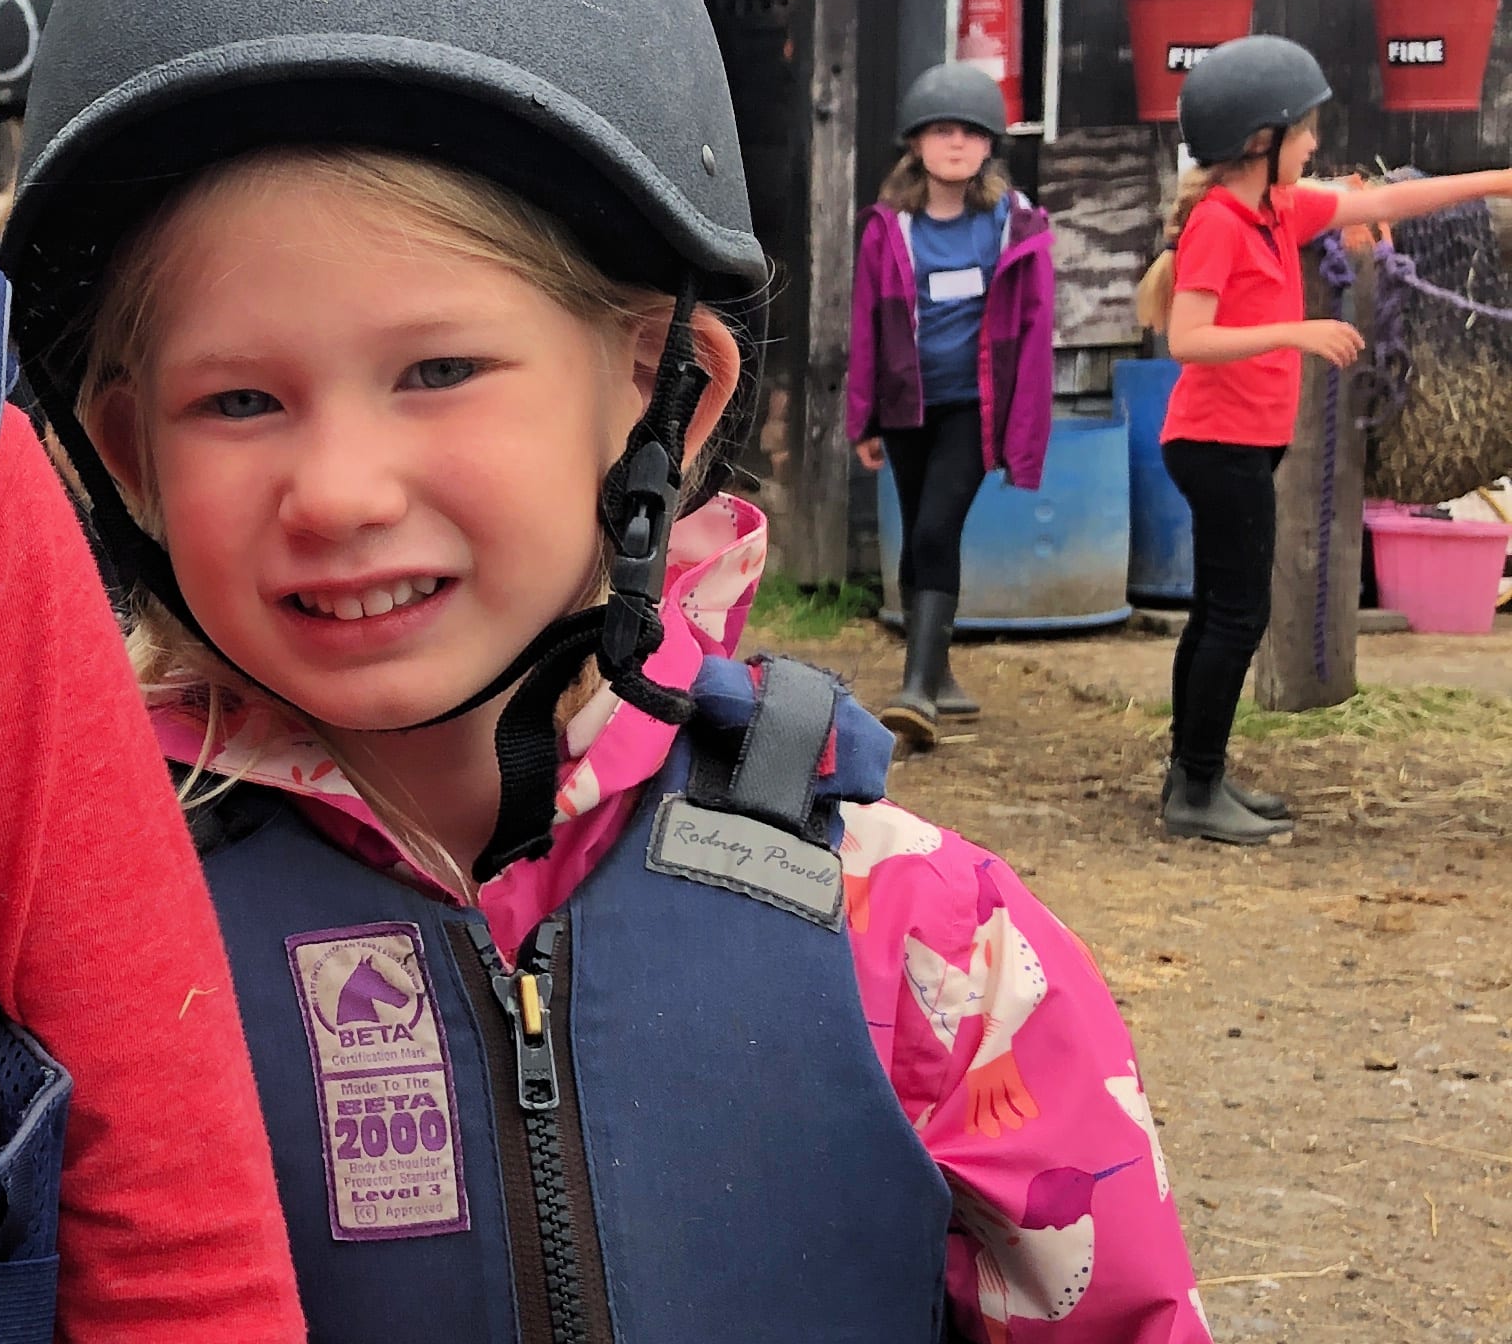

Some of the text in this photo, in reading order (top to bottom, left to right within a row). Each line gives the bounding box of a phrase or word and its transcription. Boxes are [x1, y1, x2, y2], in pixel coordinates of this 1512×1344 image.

[1168, 47, 1212, 69] FI
[1388, 40, 1443, 63] FIRE
[673, 821, 833, 886] Rodney Powell
[338, 1023, 414, 1048] BETA
[331, 1047, 426, 1066] Certification Mark
[341, 1077, 430, 1095] Made To The
[337, 1093, 437, 1115] BETA
[335, 1109, 448, 1159] 2000
[349, 1157, 441, 1174] Body & Shoulder
[344, 1169, 448, 1187] Protector Standard
[351, 1184, 441, 1202] Level 3
[386, 1203, 444, 1218] Approved
